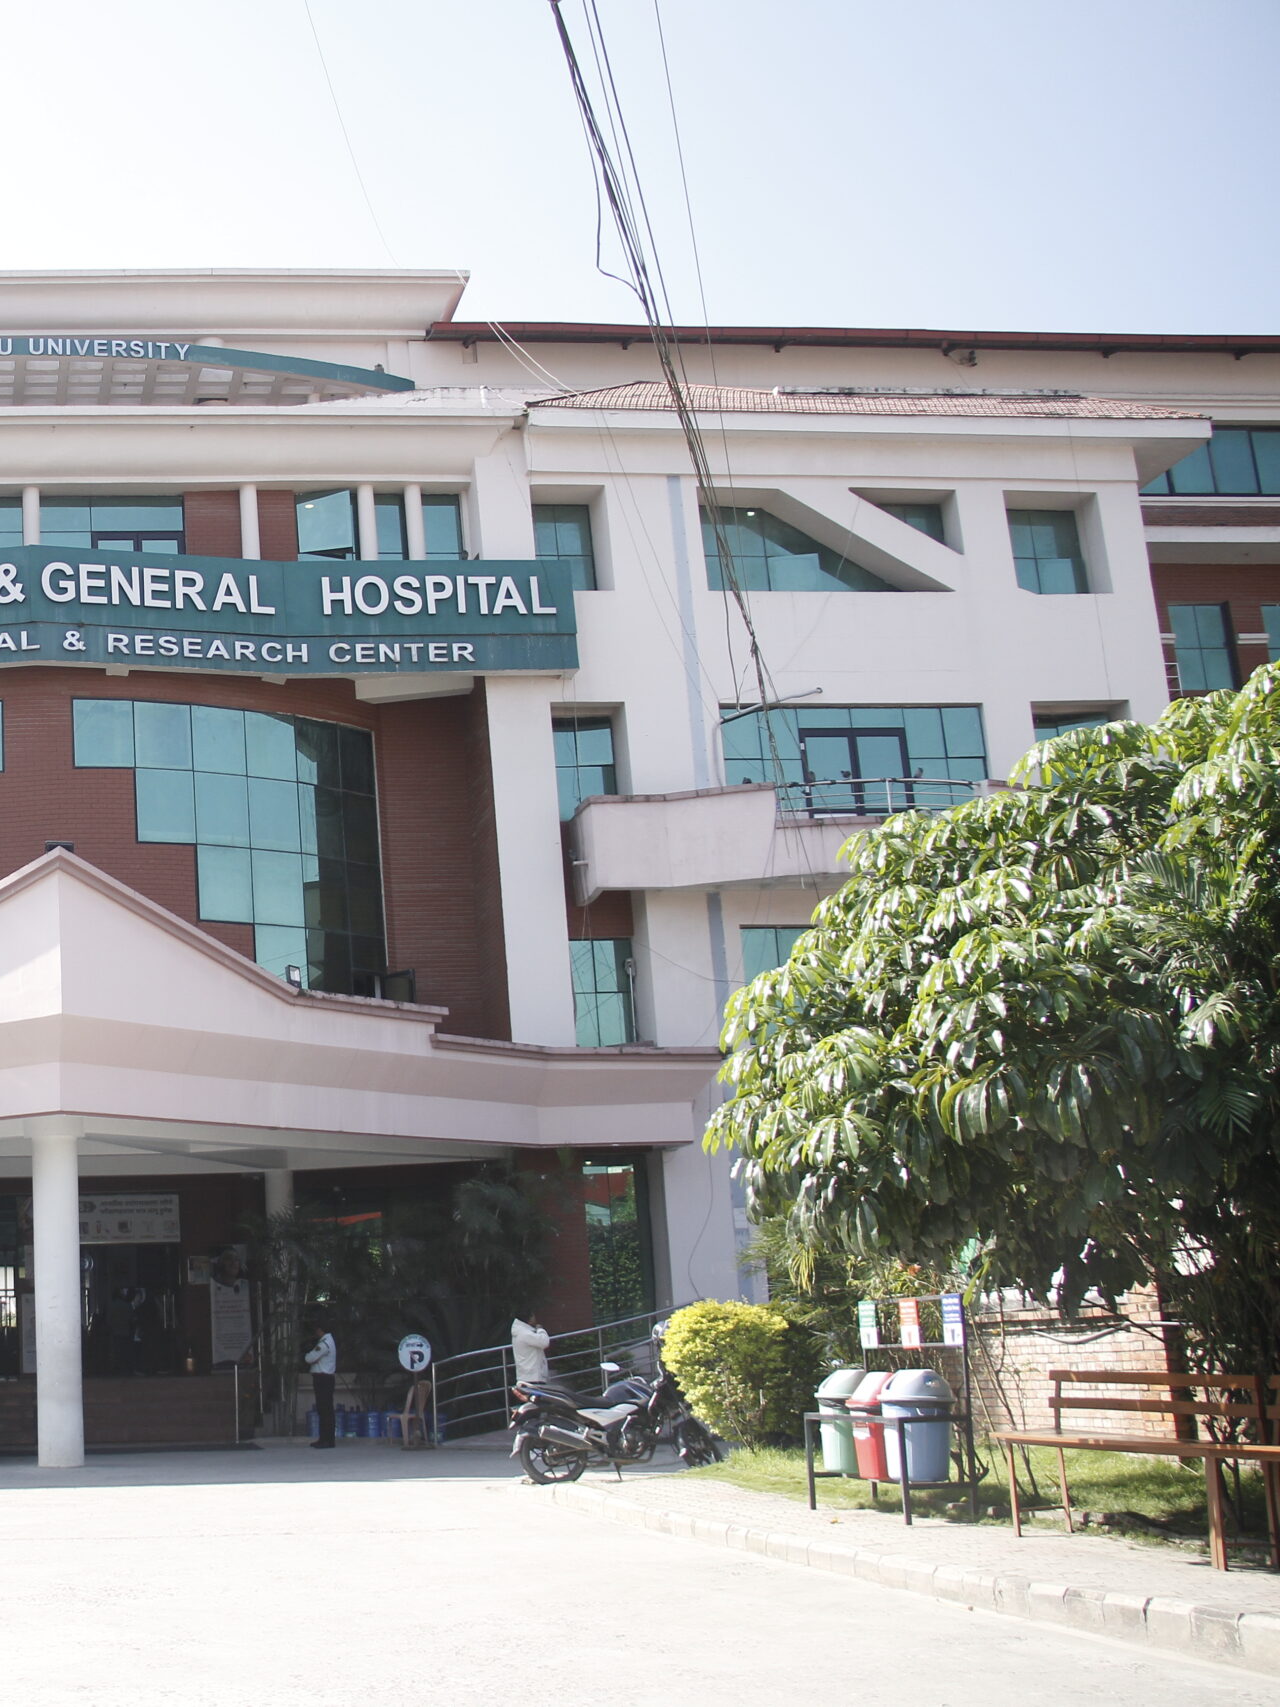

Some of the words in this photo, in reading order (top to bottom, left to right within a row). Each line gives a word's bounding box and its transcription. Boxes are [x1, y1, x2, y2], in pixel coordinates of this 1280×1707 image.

[29, 338, 190, 361] UNIVERSITY
[41, 561, 276, 616] GENERAL
[321, 575, 557, 616] HOSPITAL
[62, 630, 87, 652] &
[107, 632, 309, 664] RESEARCH
[328, 642, 476, 664] CENTER
